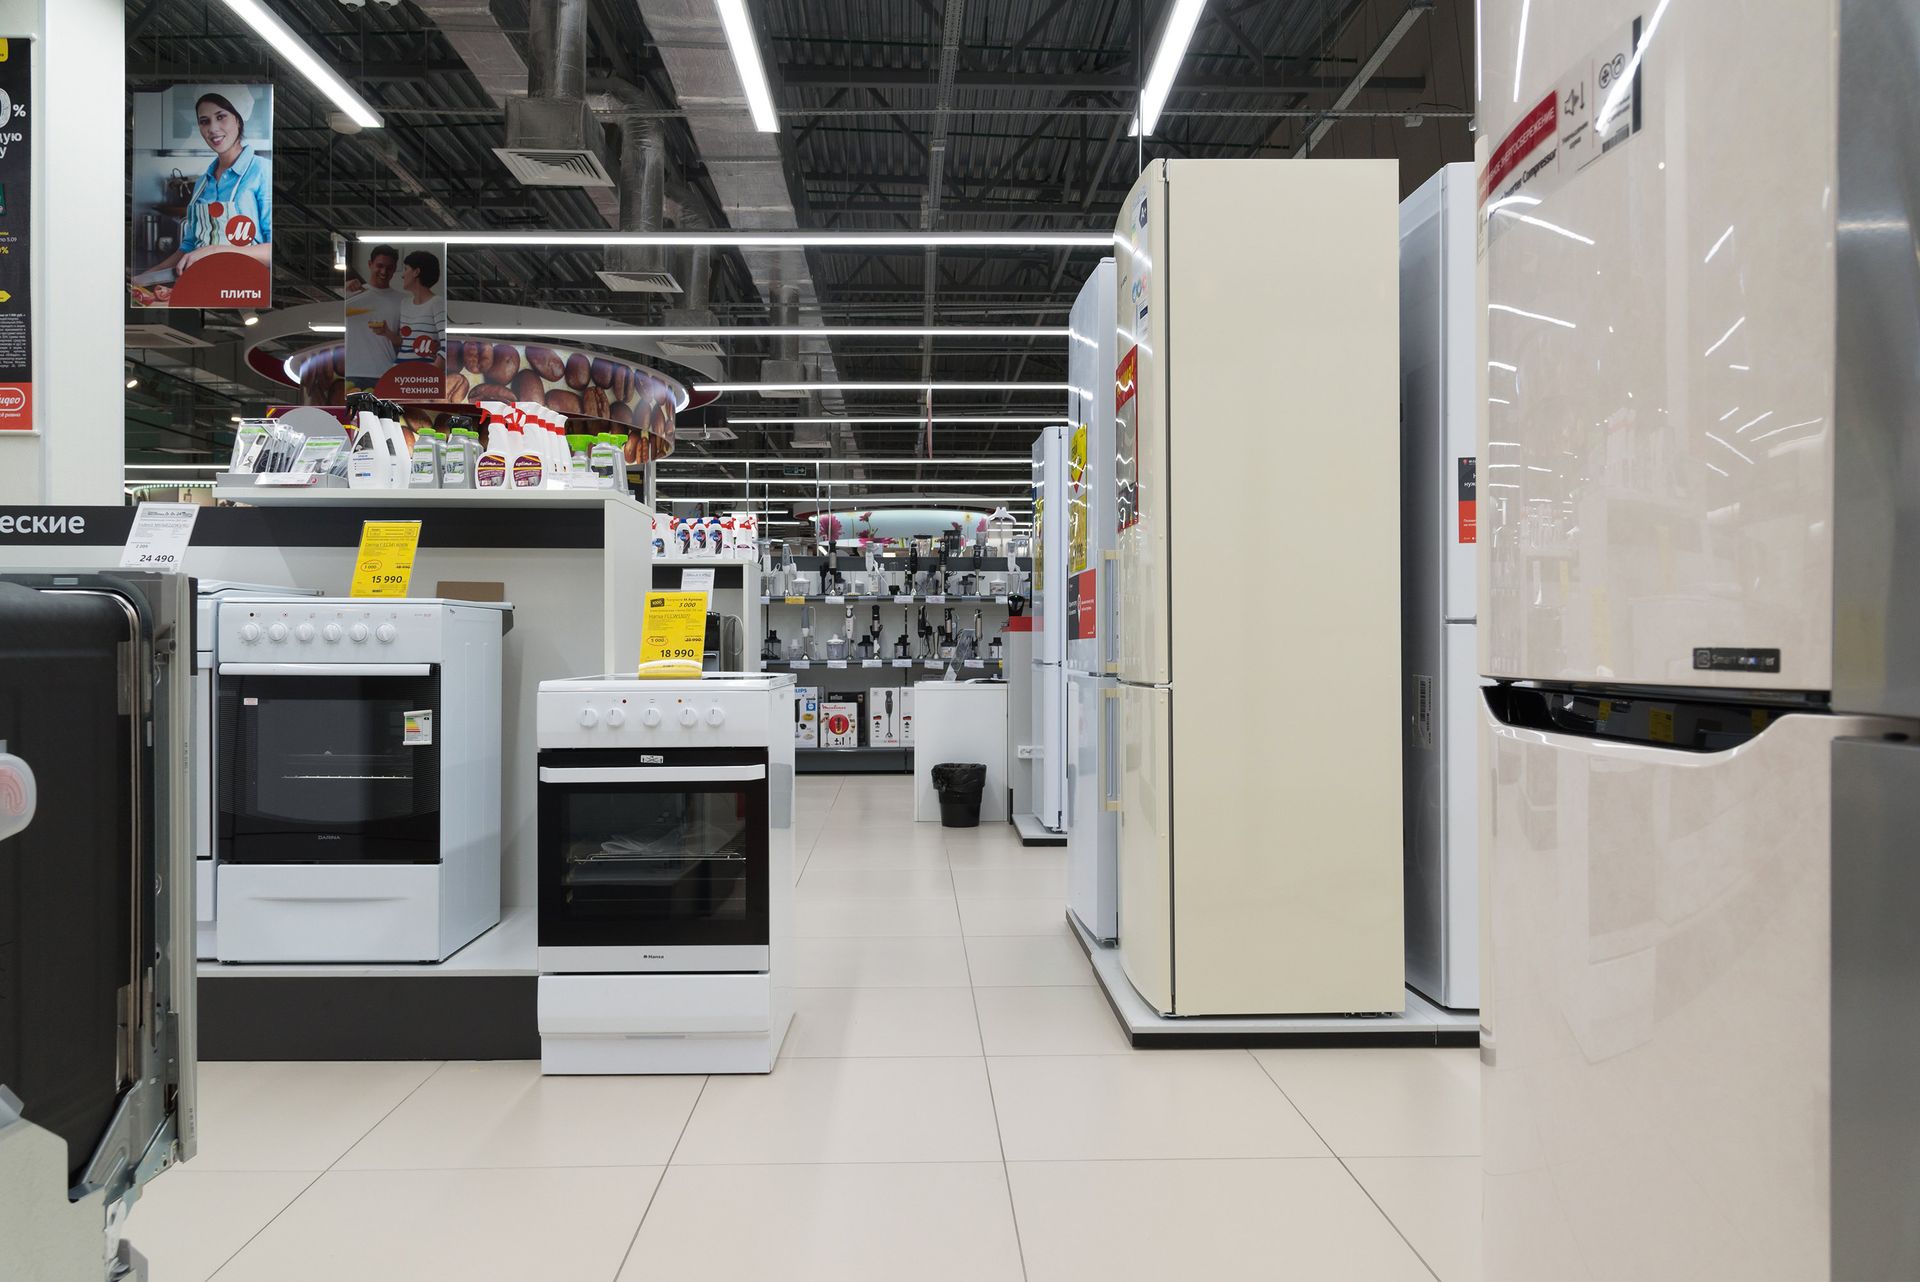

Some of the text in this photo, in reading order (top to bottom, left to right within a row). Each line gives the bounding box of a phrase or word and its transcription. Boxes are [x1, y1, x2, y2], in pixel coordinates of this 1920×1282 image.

[1522, 148, 1558, 183] Compressor
[220, 289, 262, 299] плиты
[394, 376, 440, 386] кухонная
[400, 386, 440, 394] техника
[139, 554, 175, 563] 24 490
[371, 575, 403, 584] 15 990
[660, 649, 695, 658] 18 990
